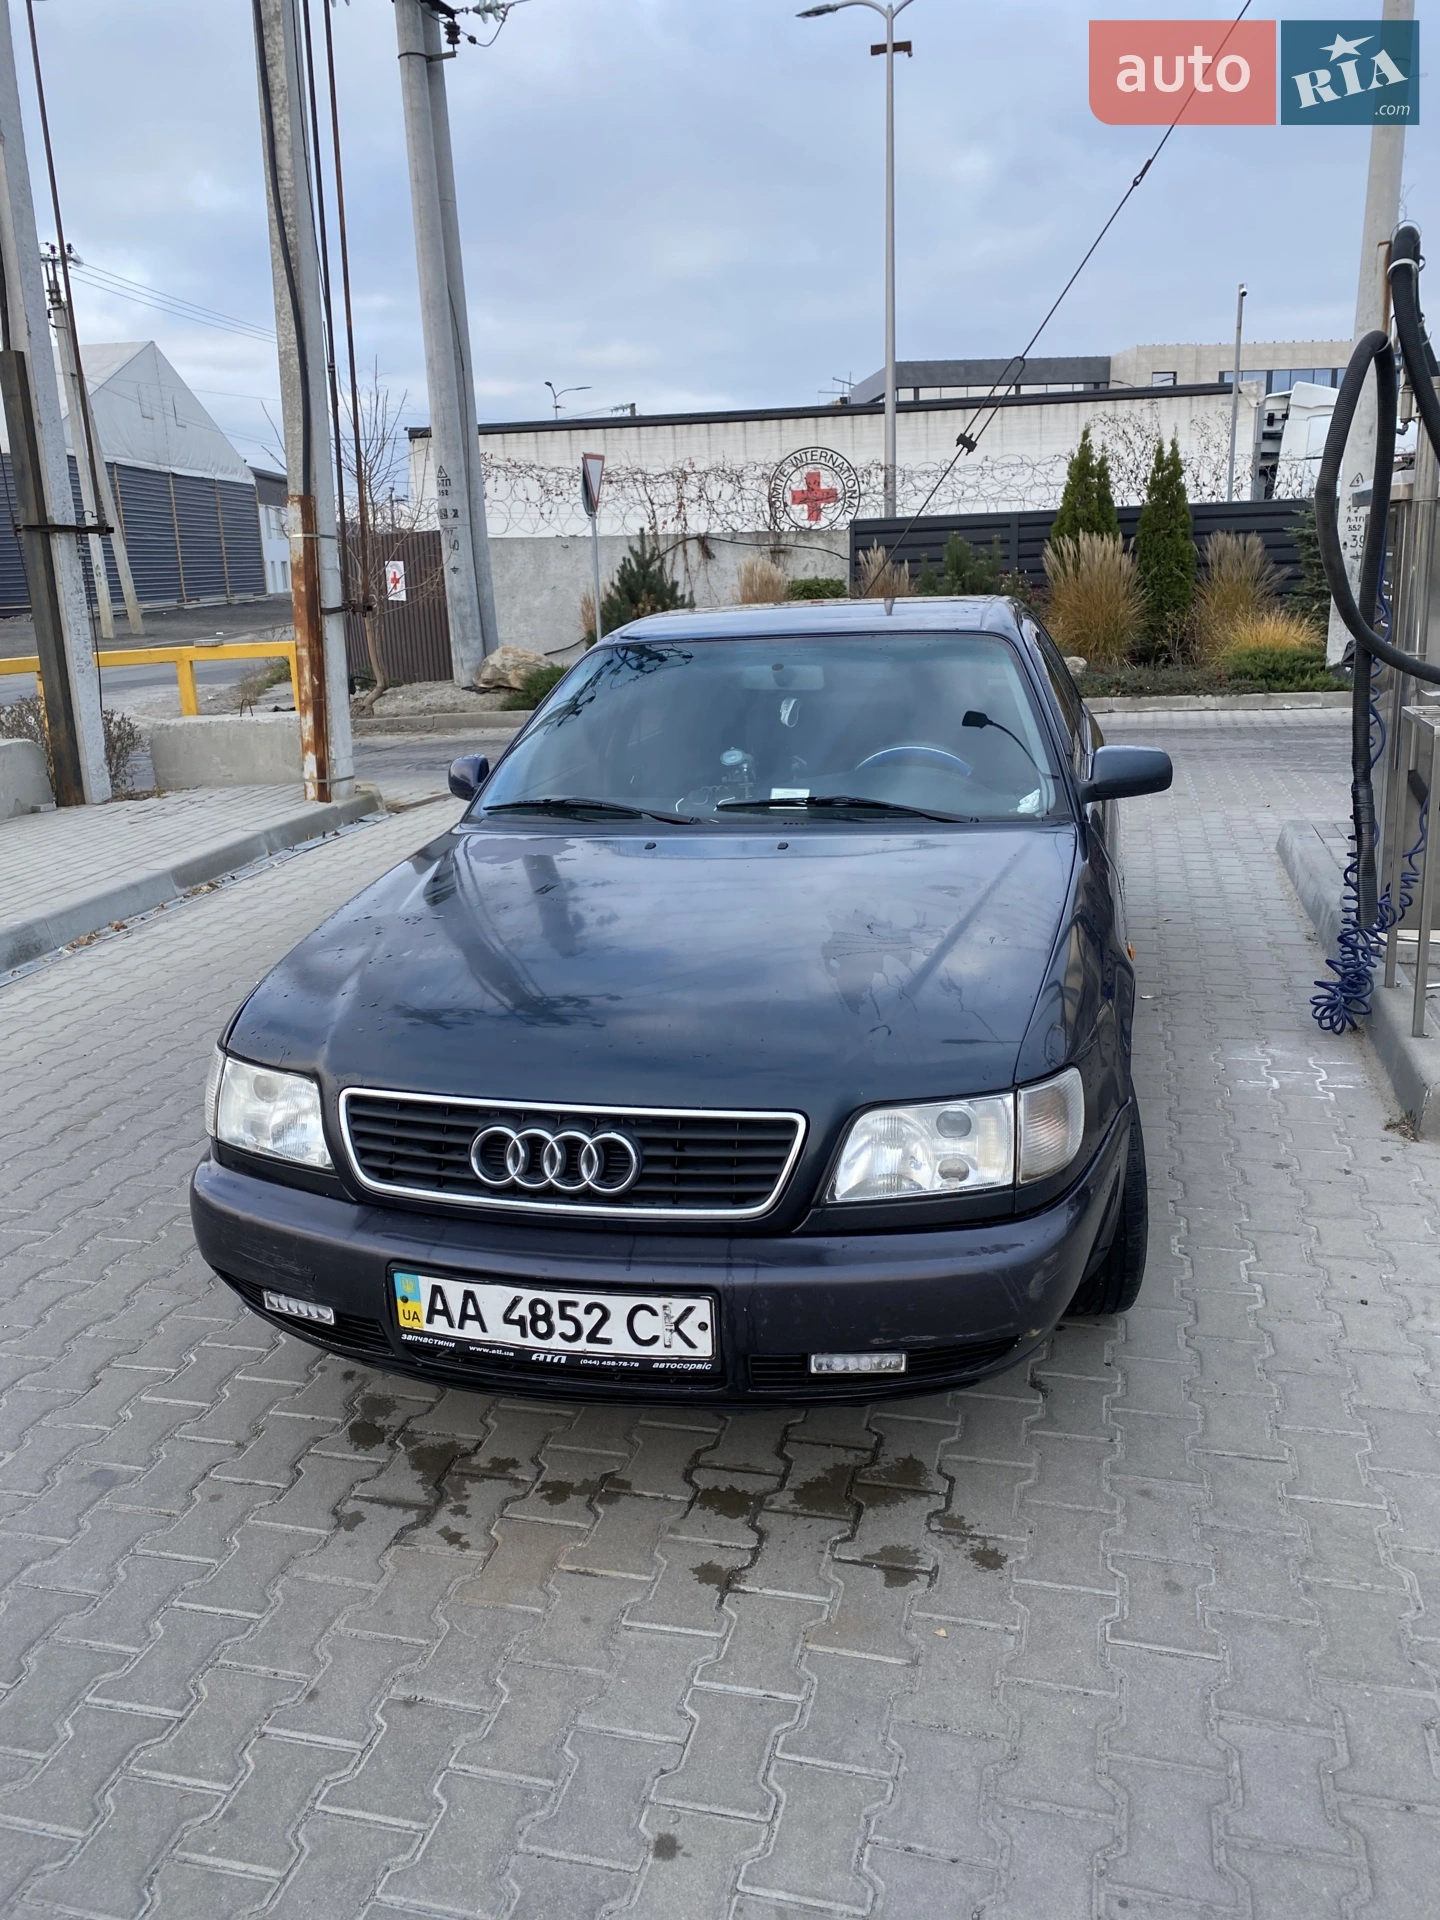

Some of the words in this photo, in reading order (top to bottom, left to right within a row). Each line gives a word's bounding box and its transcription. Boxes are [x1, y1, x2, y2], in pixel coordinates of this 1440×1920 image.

[771, 466, 790, 519] COMITE
[790, 449, 858, 516] INTERNATIONAL
[402, 1309, 421, 1323] UA
[425, 1284, 489, 1334] AA
[503, 1295, 612, 1346] 4852
[626, 1303, 699, 1350] CK
[401, 1333, 456, 1348] запчастини
[652, 1362, 712, 1371] автосервіс
